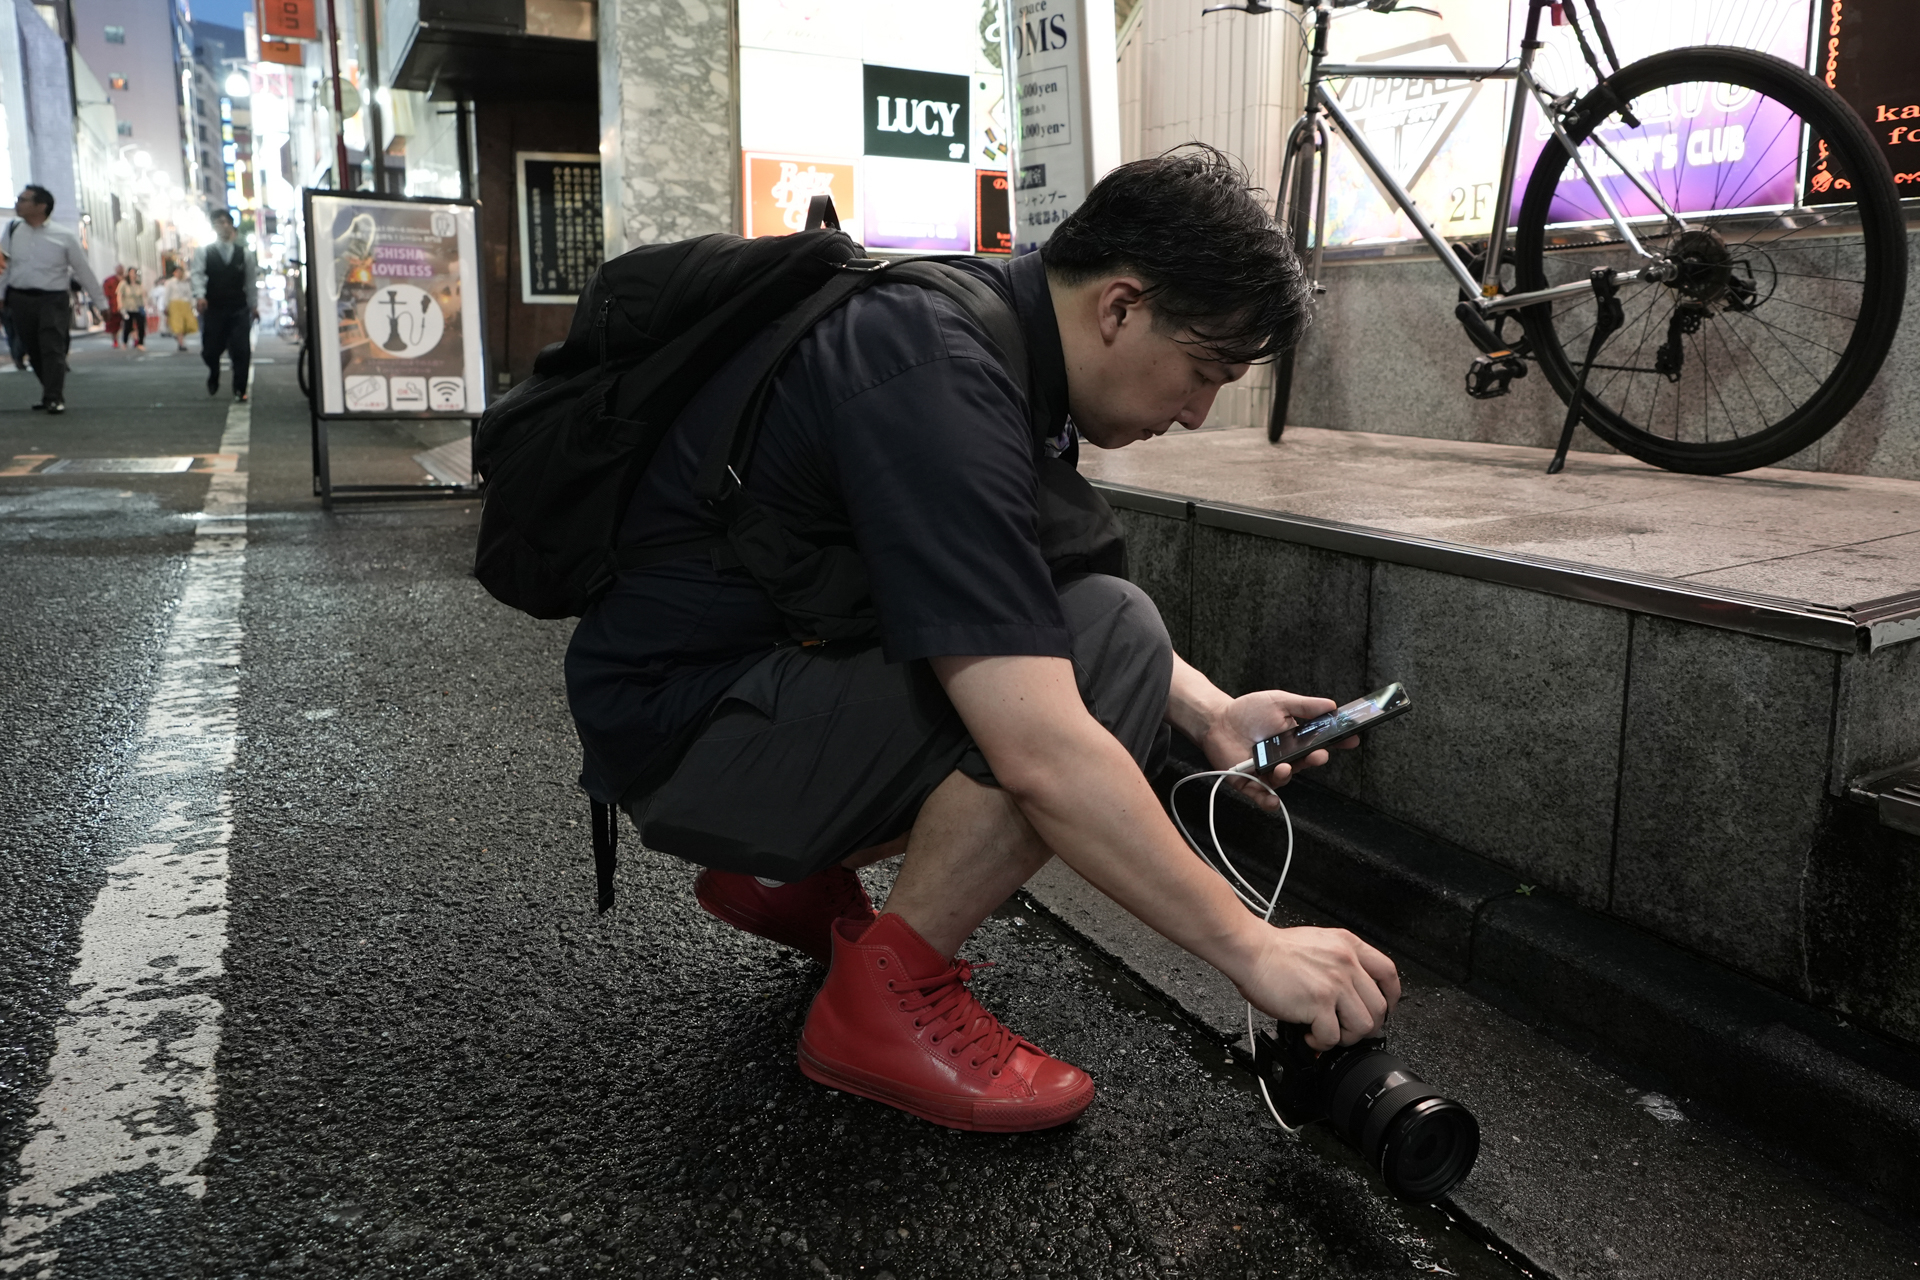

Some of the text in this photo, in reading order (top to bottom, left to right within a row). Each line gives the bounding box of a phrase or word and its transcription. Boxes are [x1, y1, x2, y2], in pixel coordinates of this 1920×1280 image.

[877, 96, 960, 137] LUCY
[1686, 125, 1745, 167] CLUB
[1450, 182, 1493, 222] 2F
[371, 264, 433, 278] LOVELESS
[376, 248, 425, 262] SHISHA
